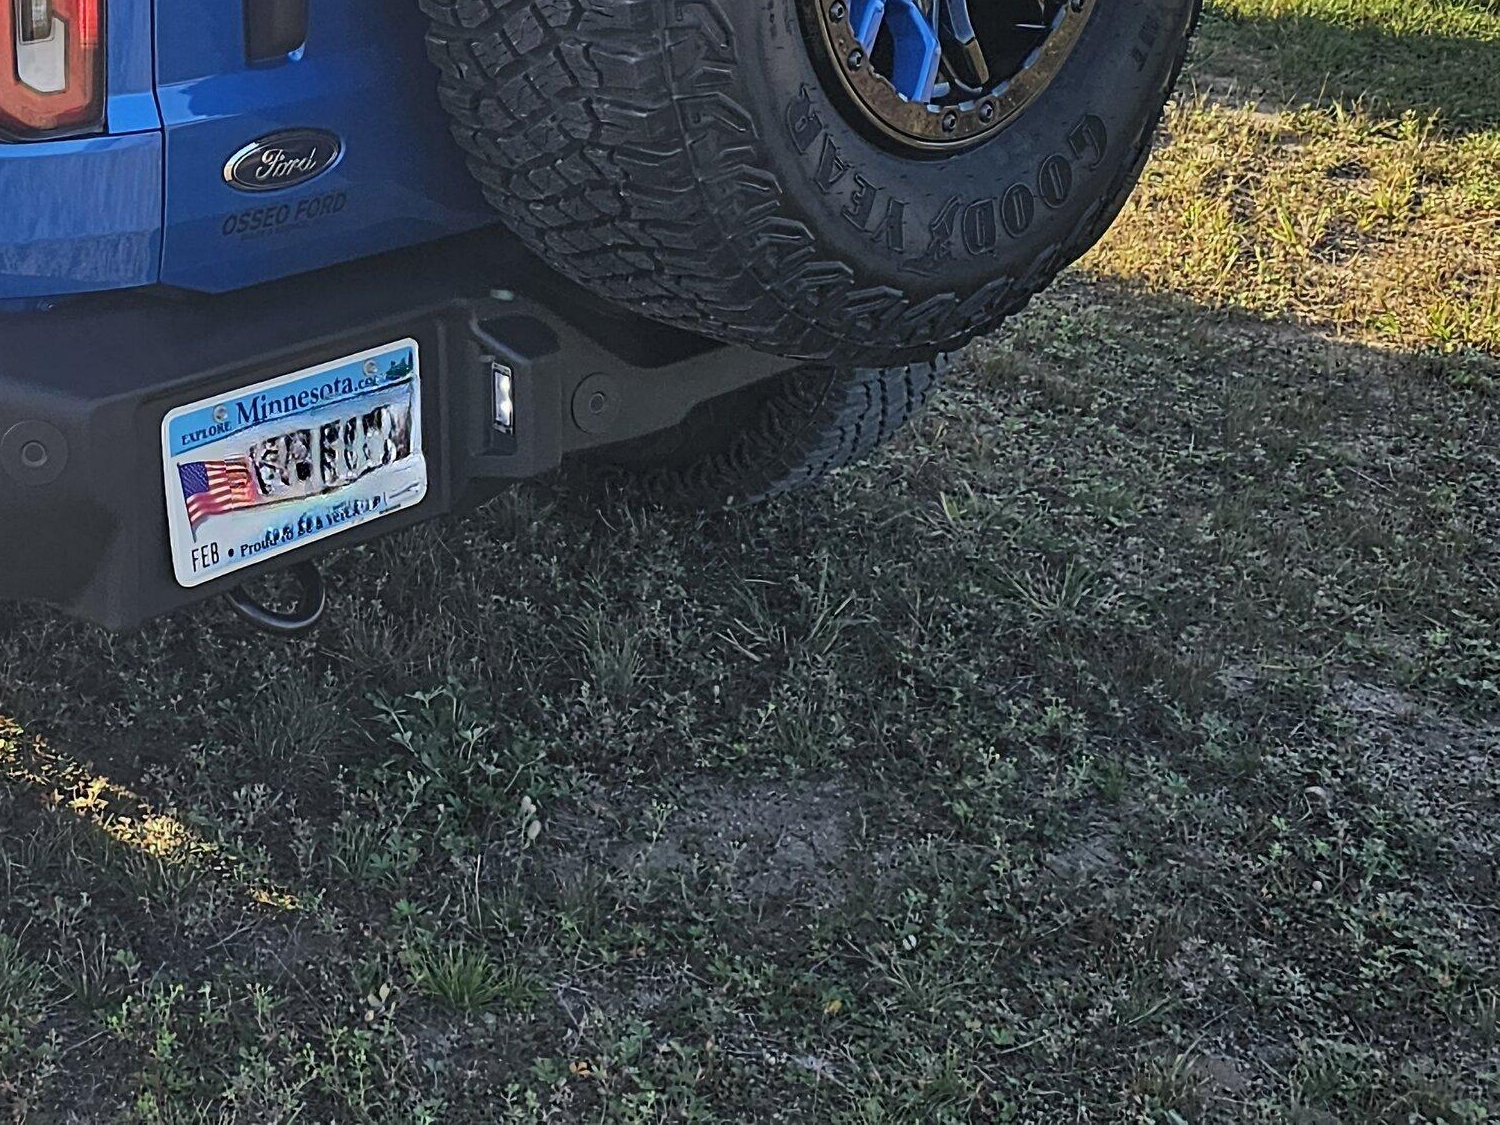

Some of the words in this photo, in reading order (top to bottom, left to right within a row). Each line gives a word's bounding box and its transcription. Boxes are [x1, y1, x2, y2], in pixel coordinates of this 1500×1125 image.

[254, 147, 317, 179] Ford
[222, 203, 289, 236] OSSEO
[294, 192, 347, 221] FORD
[191, 541, 220, 573] FEB
